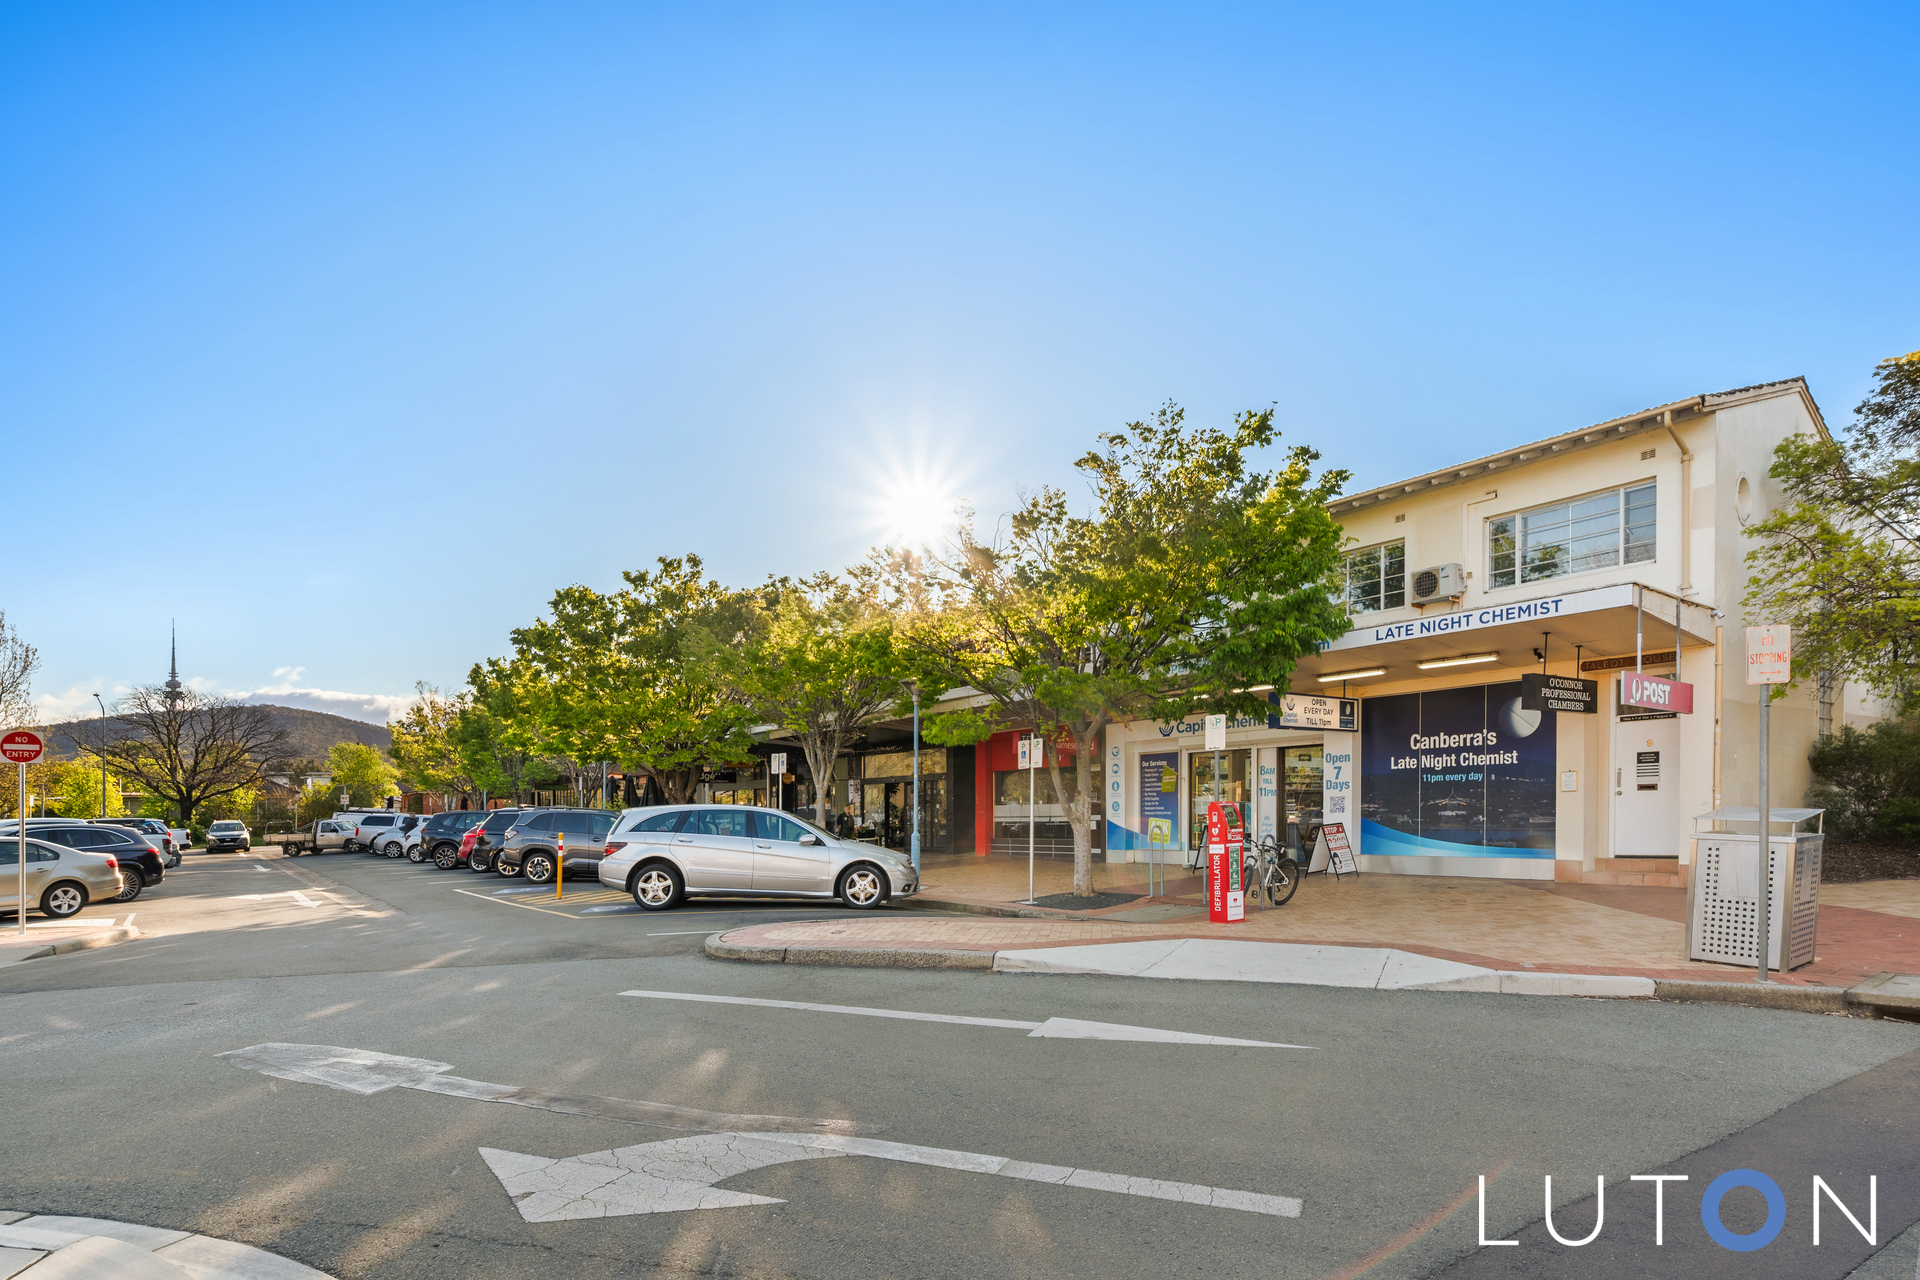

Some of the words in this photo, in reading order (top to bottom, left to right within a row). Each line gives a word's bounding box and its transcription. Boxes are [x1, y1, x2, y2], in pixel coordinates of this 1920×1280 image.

[1375, 623, 1415, 642] LATE
[1420, 613, 1473, 635] NIGHT
[1479, 598, 1563, 625] CHEMIST
[1761, 634, 1774, 646] NO
[1584, 659, 1624, 670] TALBOT
[1634, 652, 1676, 665] OUSE
[1749, 651, 1787, 665] STOPPING
[1549, 677, 1583, 690] O'CONNOR
[1541, 687, 1591, 701] PROFESSIONAL
[1643, 681, 1671, 705] POST
[1311, 698, 1327, 707] OPEN
[1547, 699, 1584, 711] CHAMBERS
[1303, 706, 1322, 715] EVERY
[1323, 708, 1334, 716] DAY
[1306, 717, 1318, 725] TILL
[1319, 718, 1332, 727] 11pm
[1410, 729, 1497, 750] Canberra's
[1646, 738, 1654, 748] 9
[6, 750, 36, 758] ENTRY
[1325, 753, 1351, 765] Open
[1390, 756, 1417, 770] Late
[1421, 753, 1457, 771] Night
[1460, 750, 1518, 767] Chemist
[1260, 765, 1275, 776] 8AM
[1333, 766, 1342, 780] 7
[1422, 773, 1444, 783] 11pm
[1445, 773, 1467, 782] every
[1468, 772, 1483, 781] day
[1259, 787, 1277, 797] 11PM
[1325, 780, 1350, 792] Days
[1324, 826, 1338, 835] STOP
[1213, 854, 1222, 911] DEFIBRILLATOR
